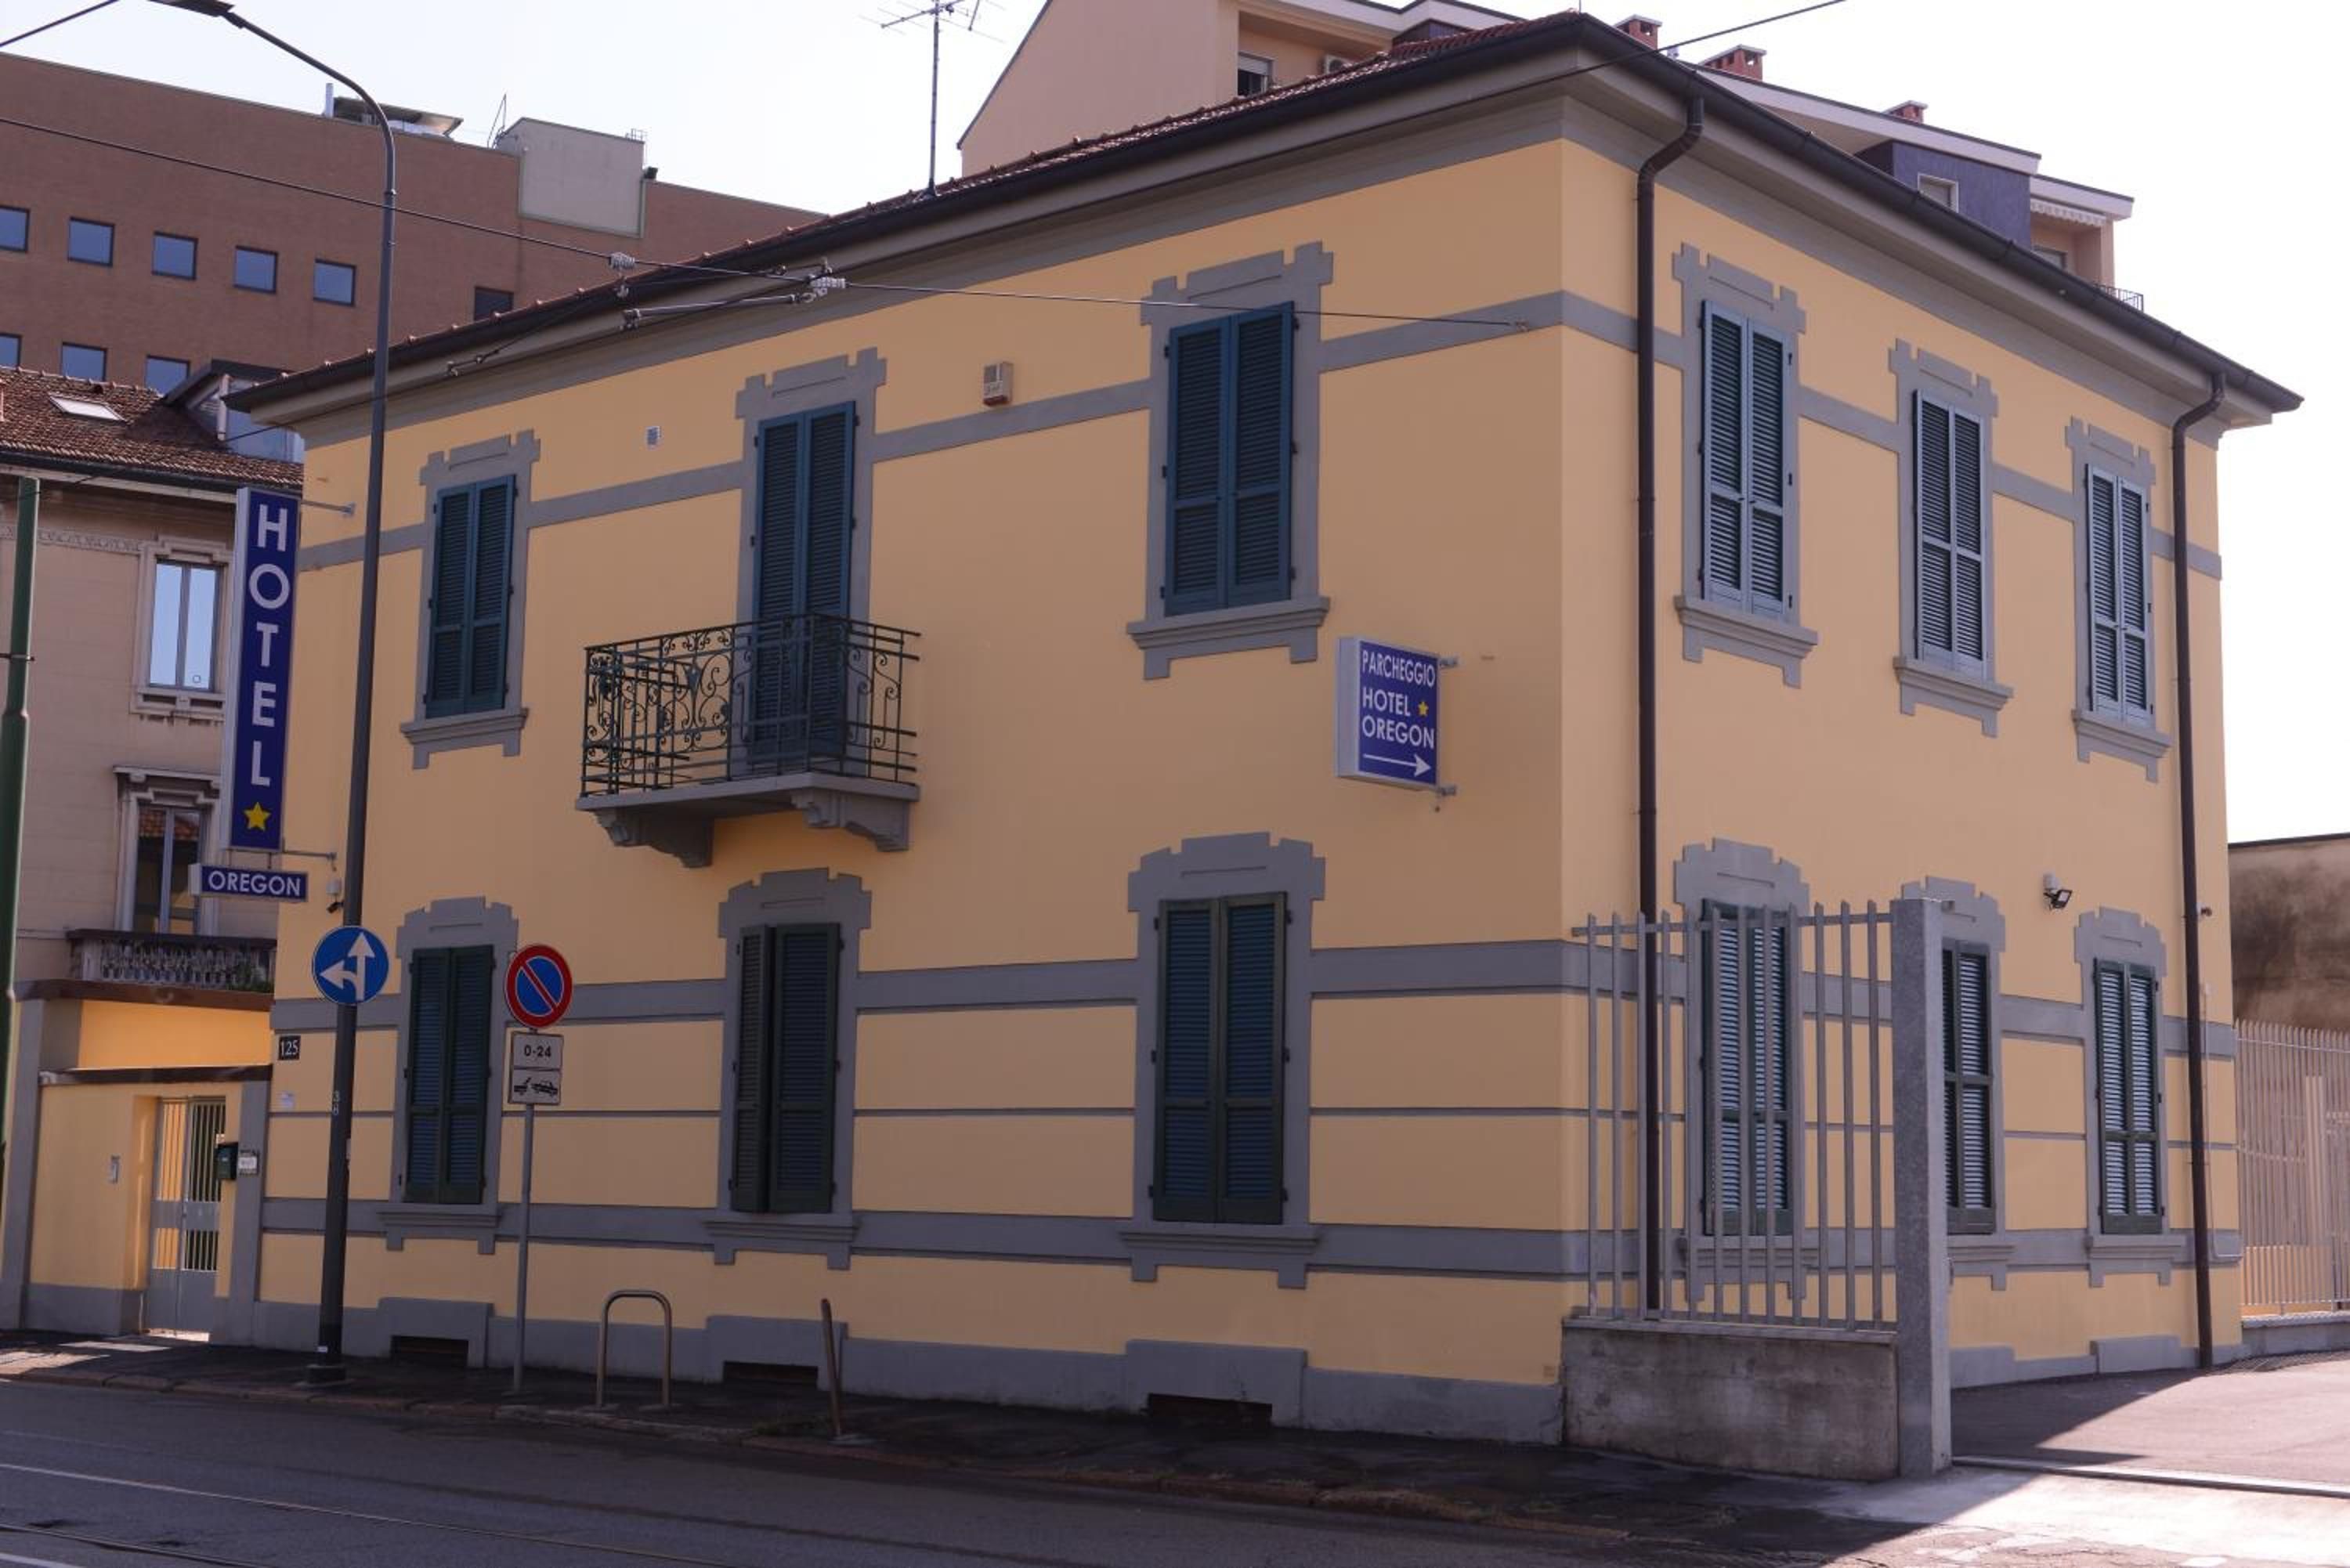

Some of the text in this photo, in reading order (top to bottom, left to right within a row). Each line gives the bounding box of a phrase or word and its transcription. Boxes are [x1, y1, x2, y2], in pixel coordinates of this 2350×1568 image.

[248, 503, 291, 787] HOTEL
[1362, 649, 1436, 688] PARCHEGGIO
[1362, 685, 1412, 717] HOTEL
[1362, 714, 1435, 750] OREGON
[208, 869, 302, 897] OREGON
[280, 1039, 298, 1056] 125
[524, 1044, 551, 1057] 0-24
